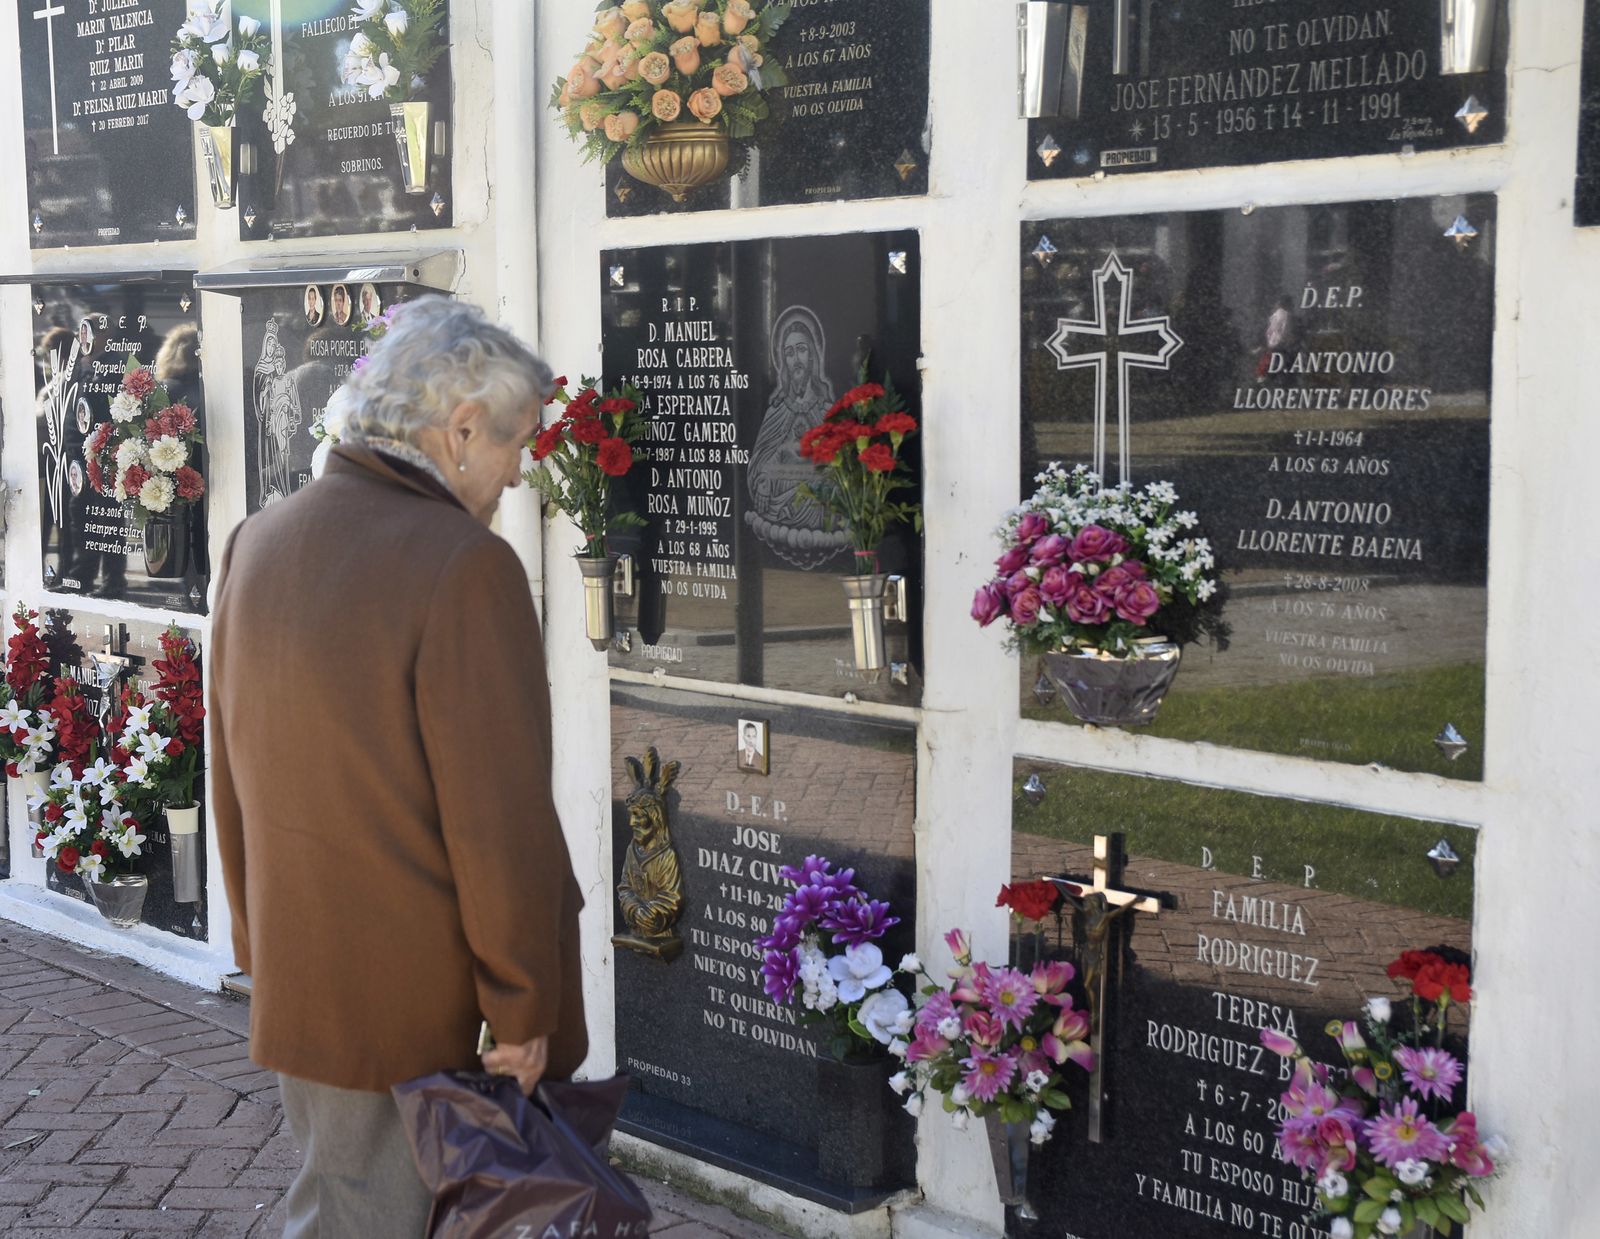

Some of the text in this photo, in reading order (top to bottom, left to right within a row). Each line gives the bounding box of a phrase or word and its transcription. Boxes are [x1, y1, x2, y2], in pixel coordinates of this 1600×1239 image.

[77, 9, 153, 37] MARIN VALENCIA
[302, 17, 345, 38] FALLECIO
[108, 34, 135, 53] PILAR
[1229, 28, 1255, 56] NO
[1263, 23, 1288, 51] TE
[90, 54, 144, 76] RUIZ MARIN
[785, 43, 872, 69] A LOS 67 AÑOS
[100, 75, 144, 91] 22 ABRIL 2009
[783, 77, 873, 99] VUESTRA FAMILIA
[1110, 49, 1428, 113] JOSE FERNANDEZ MELLADO
[84, 89, 168, 115] FELISA RUIZ MARIN
[329, 92, 336, 107] A
[339, 90, 356, 106] LOS
[792, 98, 864, 117] NO OS OLVIDA
[99, 114, 149, 131] 20 FEBRERO 2017
[327, 125, 369, 141] RECUERDO
[372, 123, 382, 136] DE
[341, 157, 383, 173] SOBRINOS.
[649, 321, 716, 342] D. MANUEL
[105, 338, 142, 355] Santiago
[310, 340, 329, 356] ROSA
[331, 341, 358, 356] PORCEL
[637, 347, 733, 368] ROSA CABRERA
[92, 360, 126, 376] Pozuelo
[678, 375, 684, 388] A
[688, 375, 705, 389] LOS
[709, 375, 719, 389] 76
[724, 370, 749, 389] AÑOS
[658, 395, 731, 416] ESPERANZA
[1233, 388, 1431, 411] LLORENTE FLORES
[636, 415, 737, 442] UÑOZ GAMERO
[680, 449, 686, 462] A
[689, 449, 705, 463] LOS
[709, 449, 721, 463] 88
[725, 445, 749, 464] AÑOS
[1269, 456, 1390, 475] A LOS 63 AÑOS
[667, 468, 722, 489] ANTONIO
[648, 491, 731, 517] ROSA MUÑOZ
[84, 520, 118, 537] siempre
[676, 520, 717, 536] 29-1-1995
[85, 540, 121, 554] recuerdo
[123, 542, 131, 555] de
[658, 539, 729, 558] A LOS 68 AÑOS
[1237, 529, 1423, 561] LLORENTE BAENA
[652, 559, 737, 579] VUESTRA FAMILIA
[661, 580, 727, 599] NO OS OLVIDA
[1284, 600, 1314, 617] LOS
[1341, 603, 1387, 621] AÑOS
[1265, 630, 1388, 654] VUESTRA FAMILIA
[1279, 653, 1375, 675] NO OS OLVIDA
[726, 790, 787, 821] D. E. P.
[732, 826, 781, 854] JOSE
[698, 848, 798, 889] DIAZ CIV
[730, 885, 784, 912] 11-10-20
[704, 904, 767, 933] A LOS 80
[1212, 890, 1306, 936] FAMILIA
[690, 928, 767, 962] TU ESPOS
[694, 954, 760, 986] NIETOS Y
[1197, 934, 1319, 986] RODRIGUEZ
[708, 985, 796, 1025] TE QUIEREN
[1212, 991, 1298, 1038] TERESA
[703, 1009, 817, 1058] NO TE OLVIDAN
[1147, 1019, 1265, 1075] RODRIGUEZ
[627, 1057, 691, 1087] PROPIEDAD 33
[1184, 1113, 1196, 1136] A
[1203, 1118, 1235, 1146] LOS
[1243, 1129, 1263, 1154] 60
[1180, 1148, 1202, 1174] TU
[1209, 1157, 1274, 1196] ESPOSO
[1135, 1173, 1146, 1196] Y
[1152, 1178, 1224, 1221] FAMILIA
[1231, 1201, 1253, 1229] NO
[1260, 1212, 1282, 1238] TE
